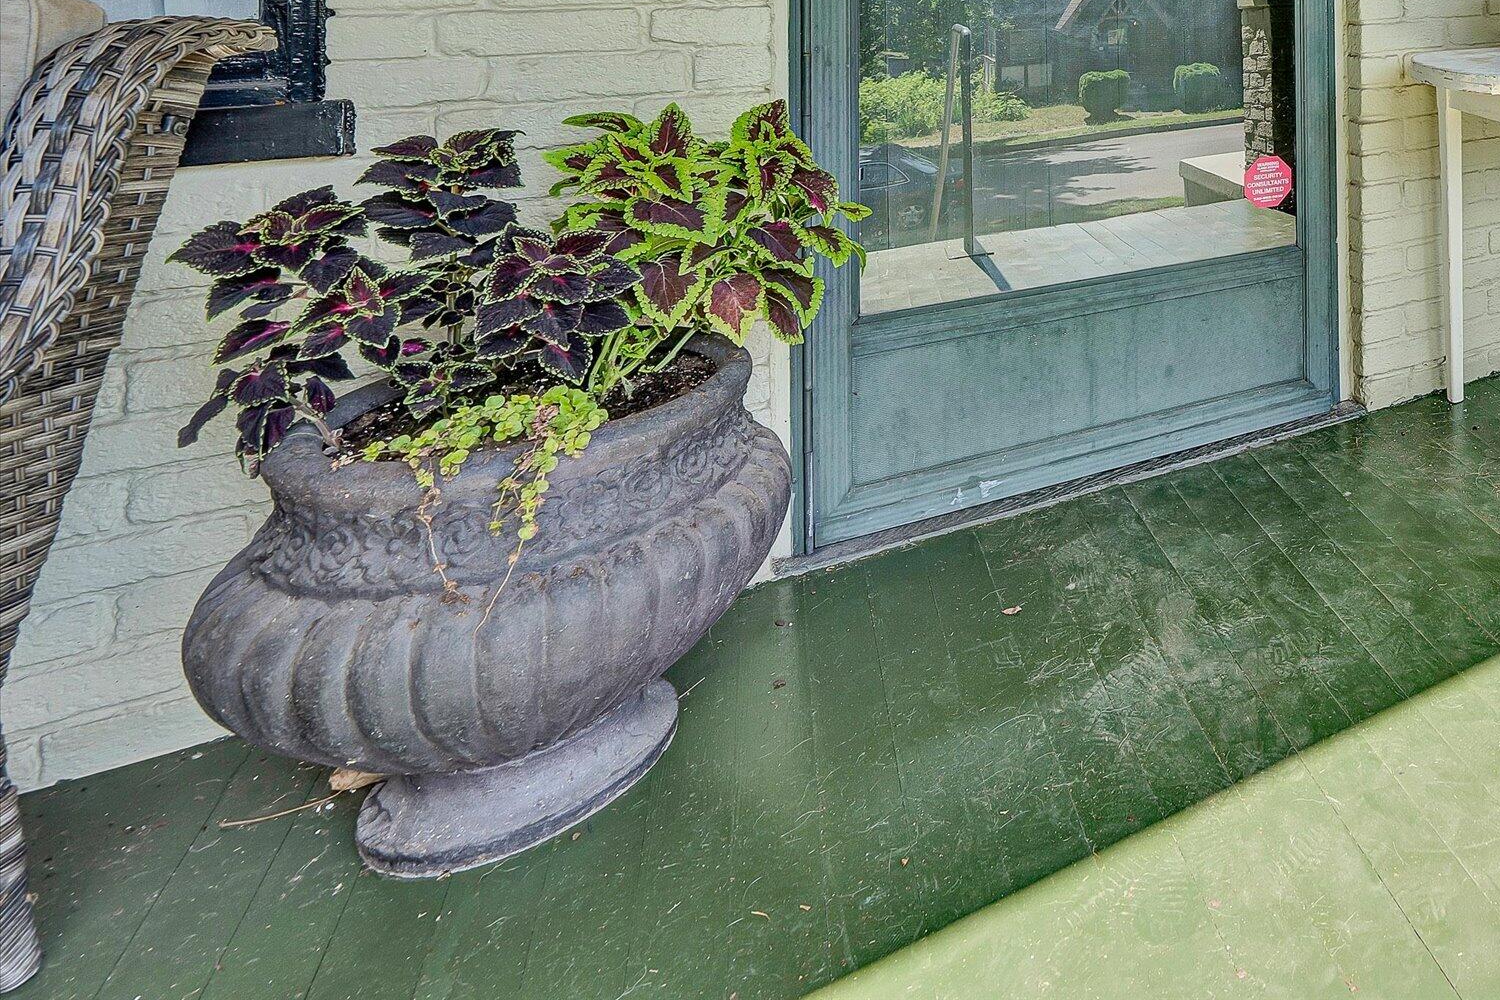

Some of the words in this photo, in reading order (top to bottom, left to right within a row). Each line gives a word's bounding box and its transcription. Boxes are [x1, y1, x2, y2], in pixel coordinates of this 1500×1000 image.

[1253, 172, 1282, 180] SECURITY
[1247, 178, 1289, 189] CONSULTANTS
[1252, 186, 1284, 195] UNLIMITED
